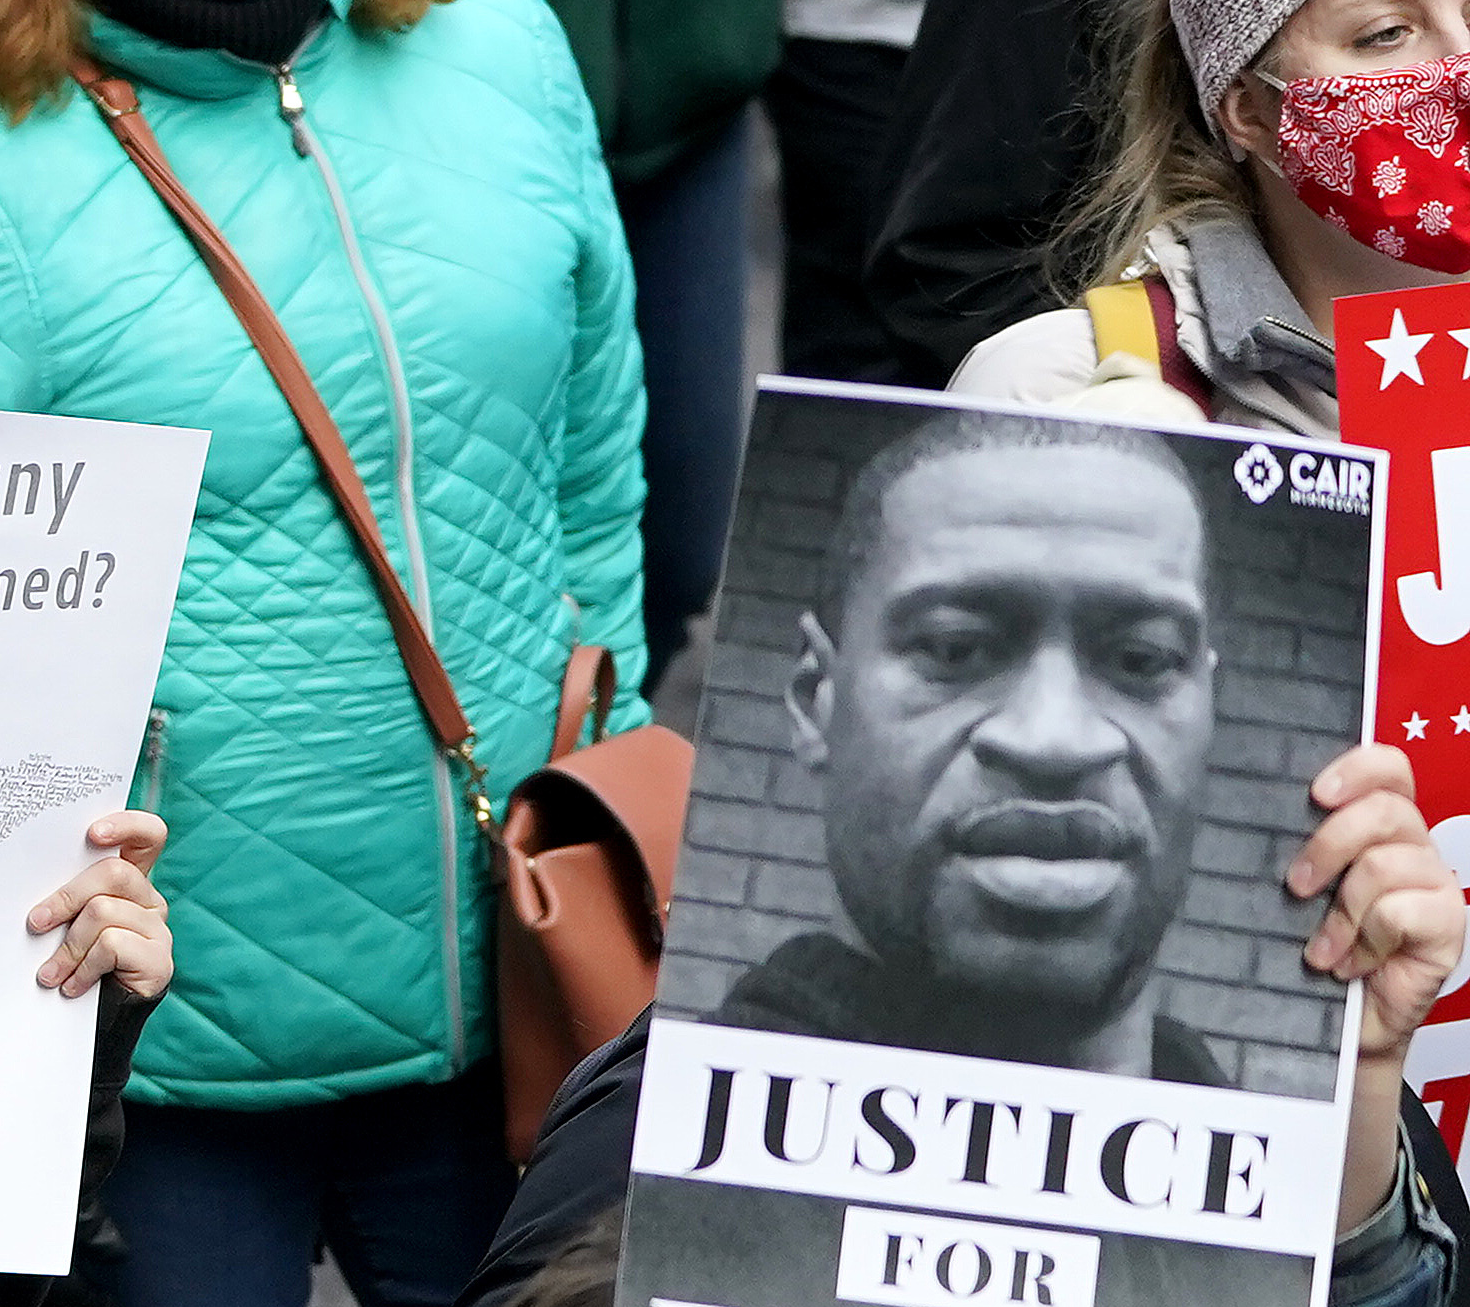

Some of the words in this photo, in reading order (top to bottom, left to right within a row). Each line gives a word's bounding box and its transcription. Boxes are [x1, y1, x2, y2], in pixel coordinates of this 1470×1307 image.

[1290, 452, 1372, 500] CAIR
[685, 1063, 1271, 1221] JUSTICE
[882, 1232, 1058, 1307] FOR
